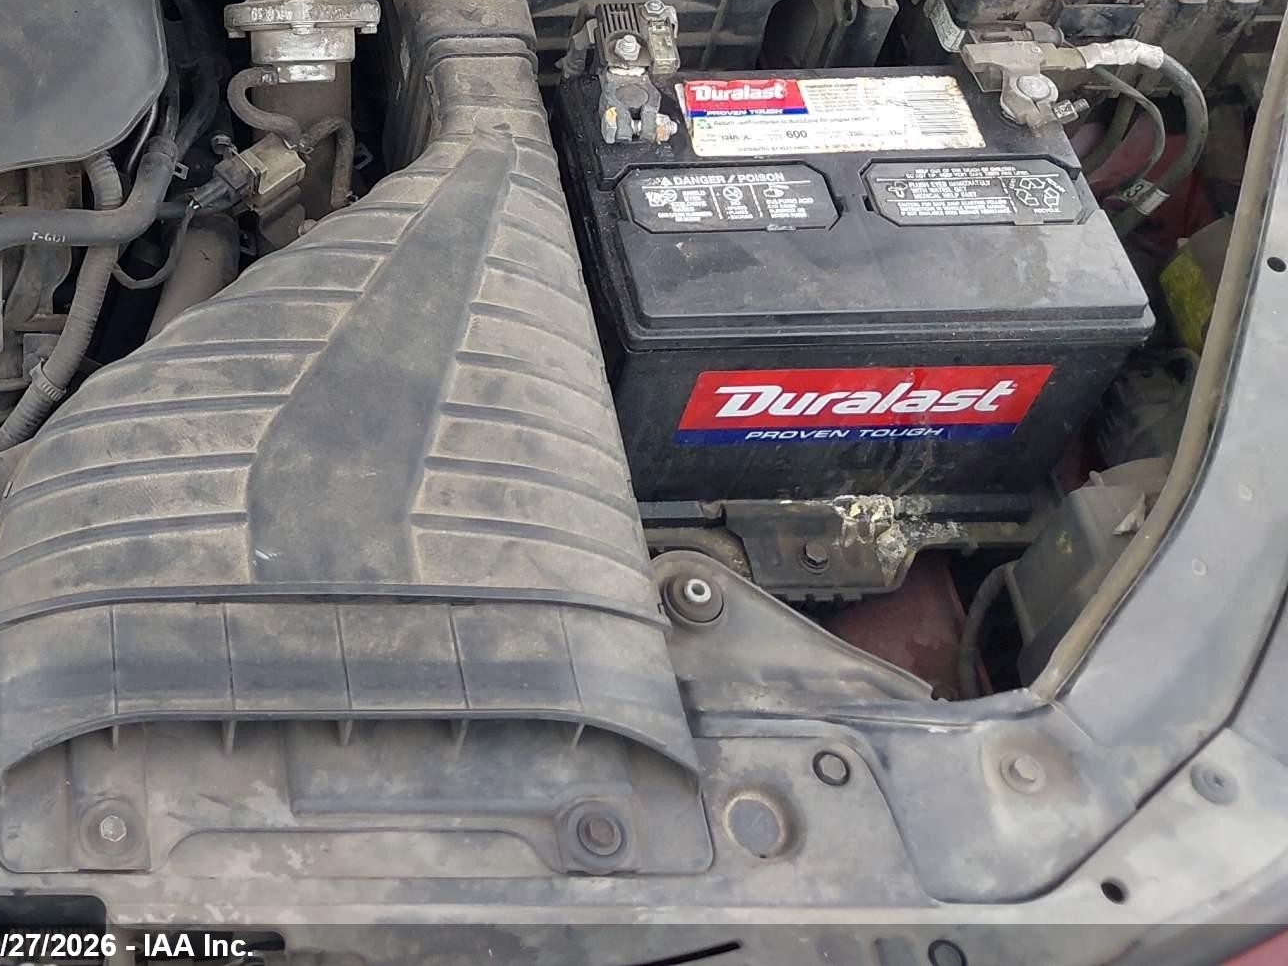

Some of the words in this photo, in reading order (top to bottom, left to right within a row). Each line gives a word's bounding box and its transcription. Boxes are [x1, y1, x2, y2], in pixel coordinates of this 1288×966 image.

[689, 84, 786, 101] Duralast
[706, 108, 747, 116] PROVEN
[749, 108, 784, 116] TOUGH
[785, 129, 808, 139] 600
[672, 174, 727, 186] DANGER
[737, 171, 786, 183] POISON
[715, 380, 1016, 418] Duralast
[744, 428, 848, 440] PROVEN
[858, 426, 944, 438] TOUGH
